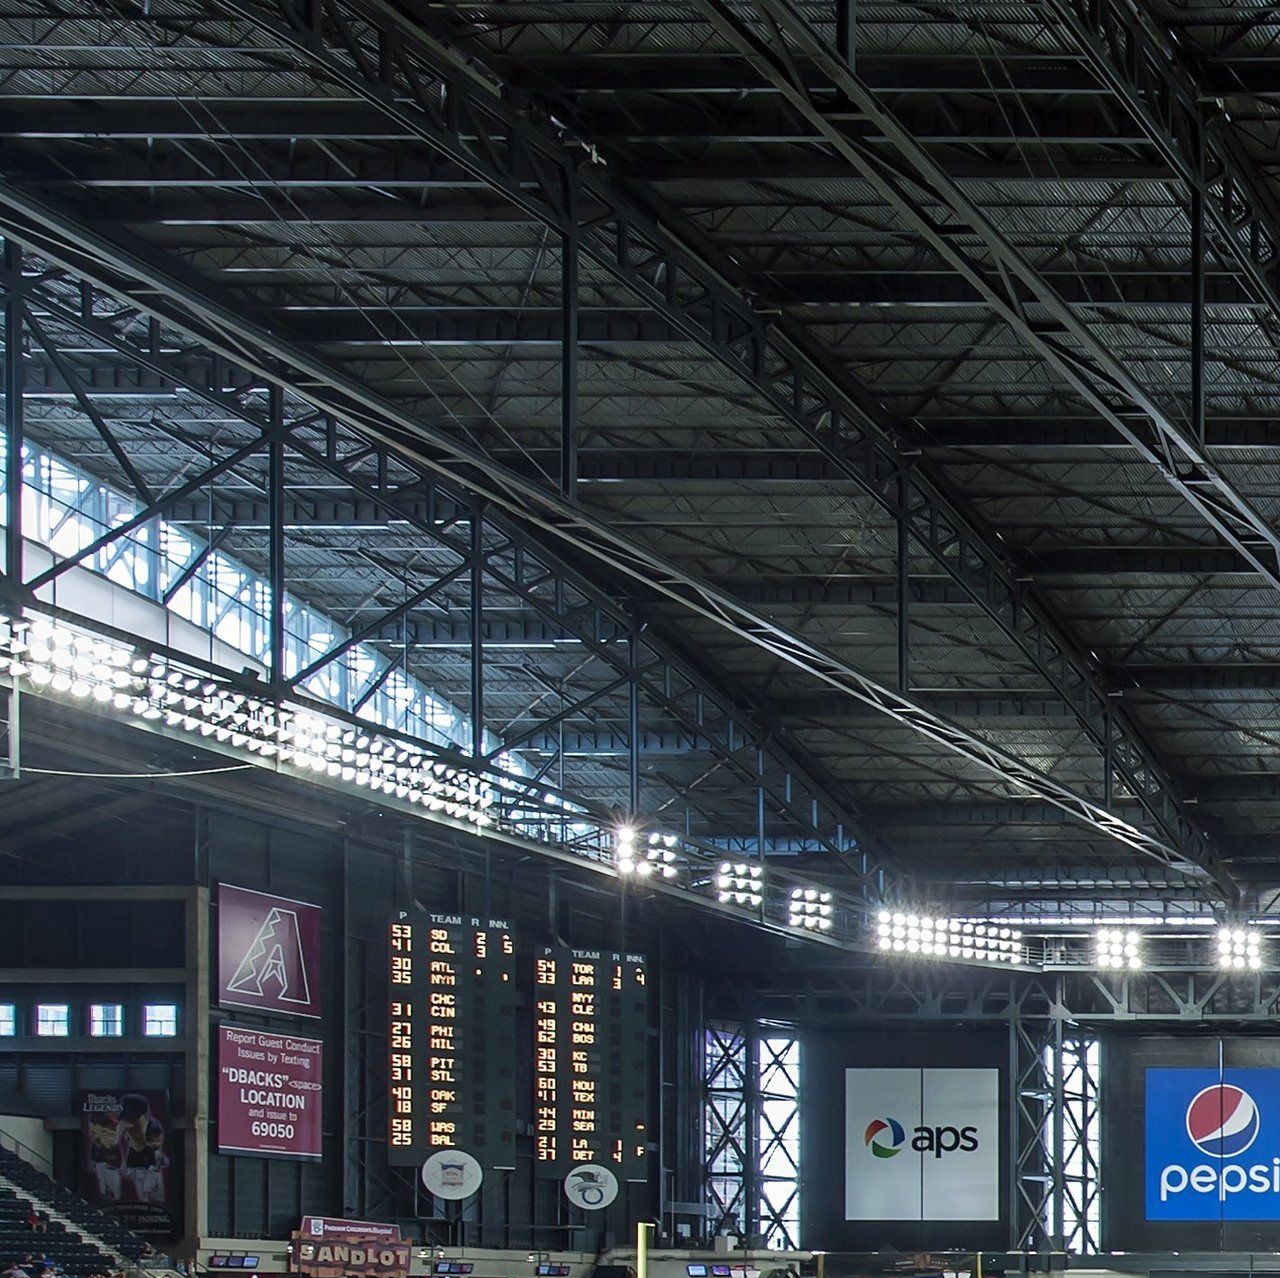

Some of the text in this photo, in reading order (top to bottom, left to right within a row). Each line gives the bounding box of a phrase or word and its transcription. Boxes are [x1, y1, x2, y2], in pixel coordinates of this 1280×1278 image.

[430, 914, 462, 924] TEAM
[392, 925, 486, 944] 53 SD 2
[393, 939, 512, 958] 41 COL 3 5
[538, 960, 621, 977] 54 TOR 1
[227, 1031, 319, 1054] Report Guest Conduct
[238, 1047, 310, 1068] Issues by Texting
[240, 1089, 305, 1109] LOCATION
[252, 1122, 294, 1139] 69050
[912, 1126, 978, 1158] aps
[1161, 1158, 1280, 1201] pepsi
[300, 1245, 408, 1266] SANDLOT
